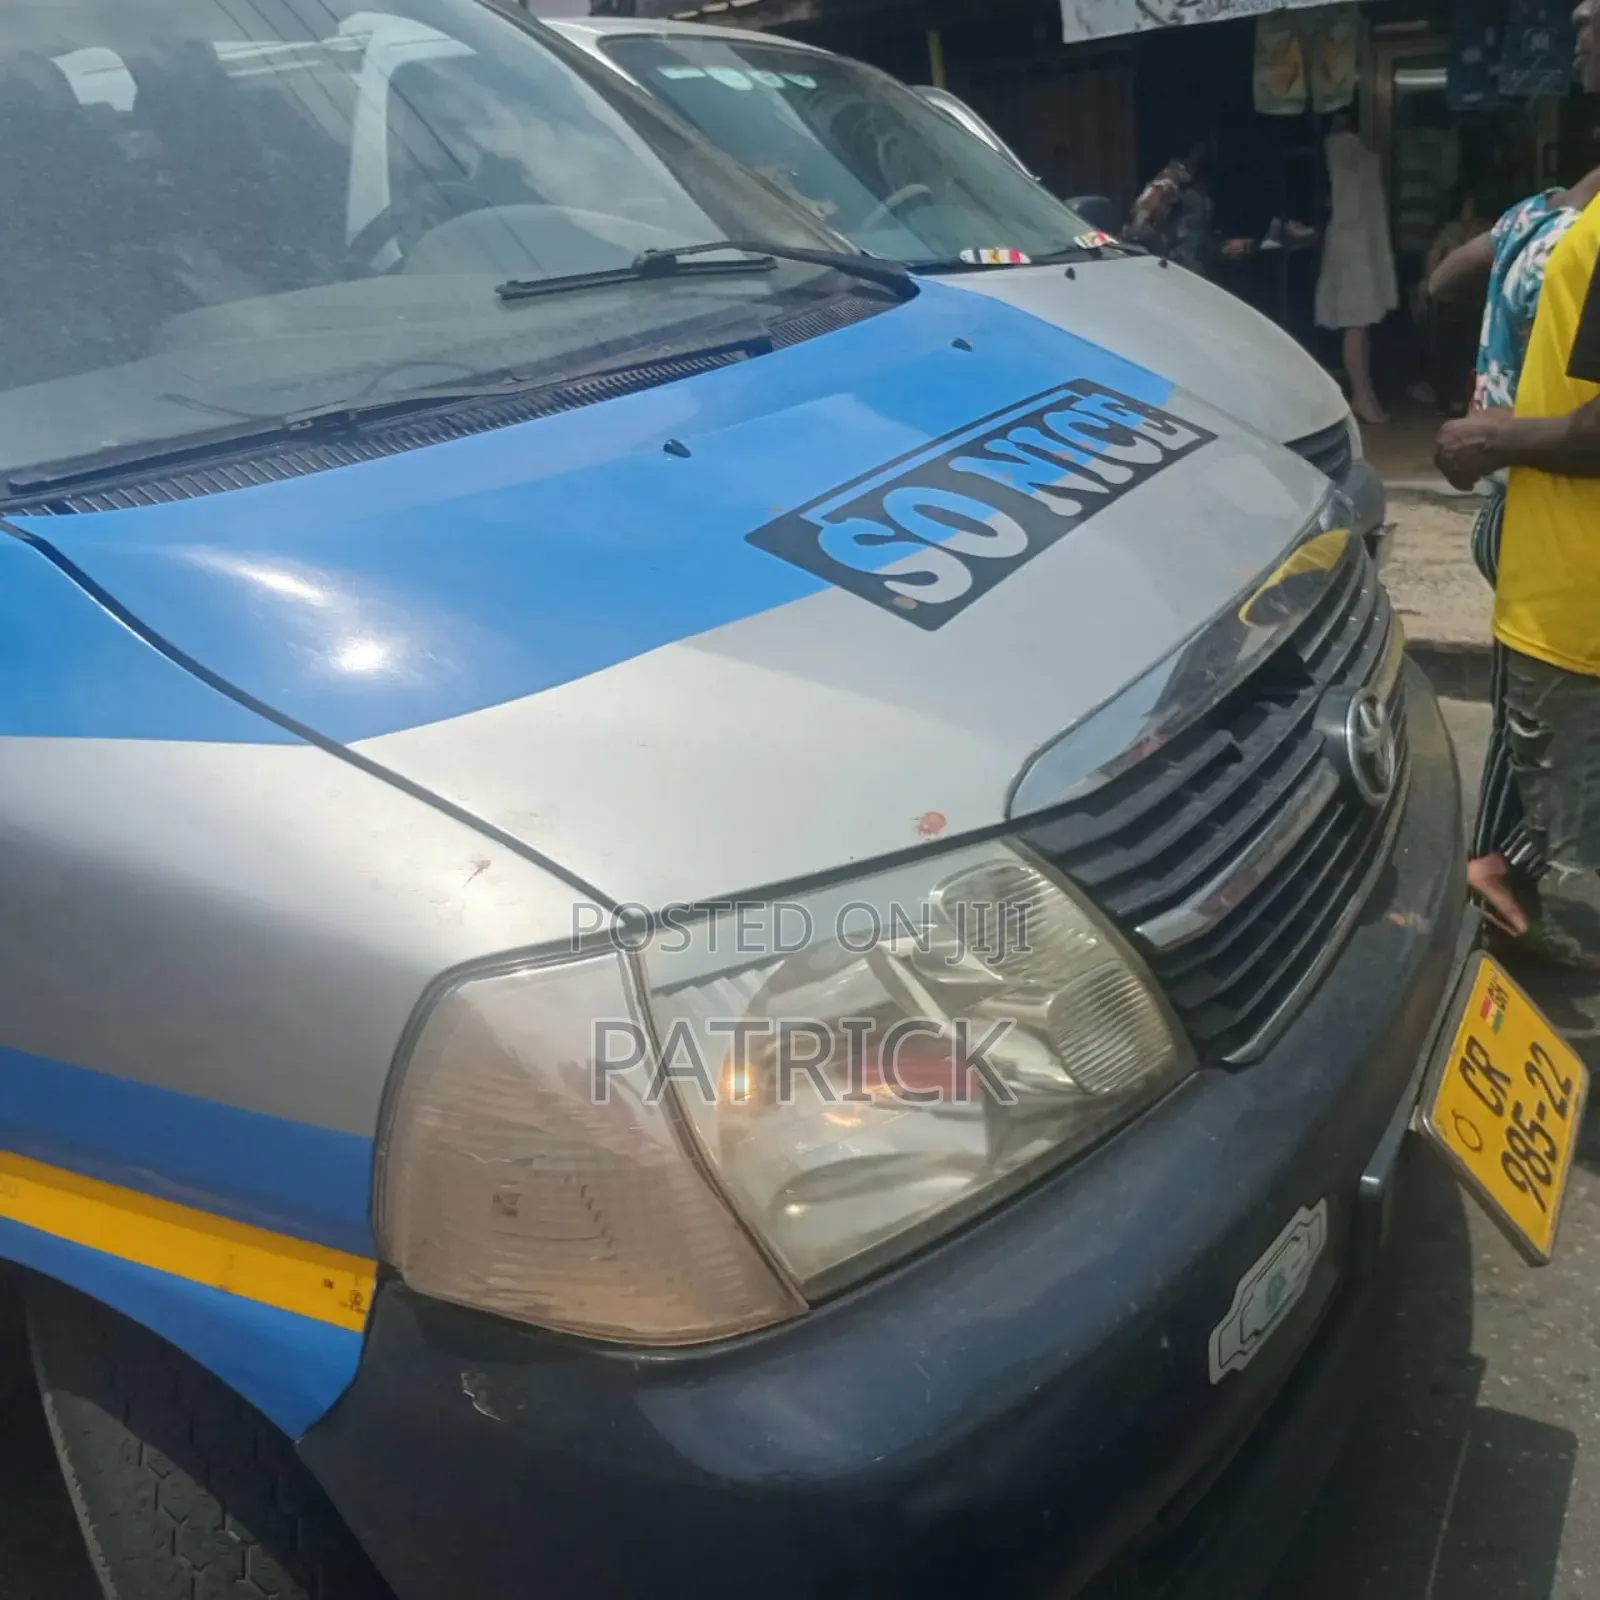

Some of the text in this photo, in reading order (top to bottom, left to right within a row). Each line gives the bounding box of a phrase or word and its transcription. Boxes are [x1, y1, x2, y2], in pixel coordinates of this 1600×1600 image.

[818, 393, 1201, 604] SO NICE
[1459, 1035, 1511, 1117] CR
[1501, 1041, 1572, 1213] 985-22
